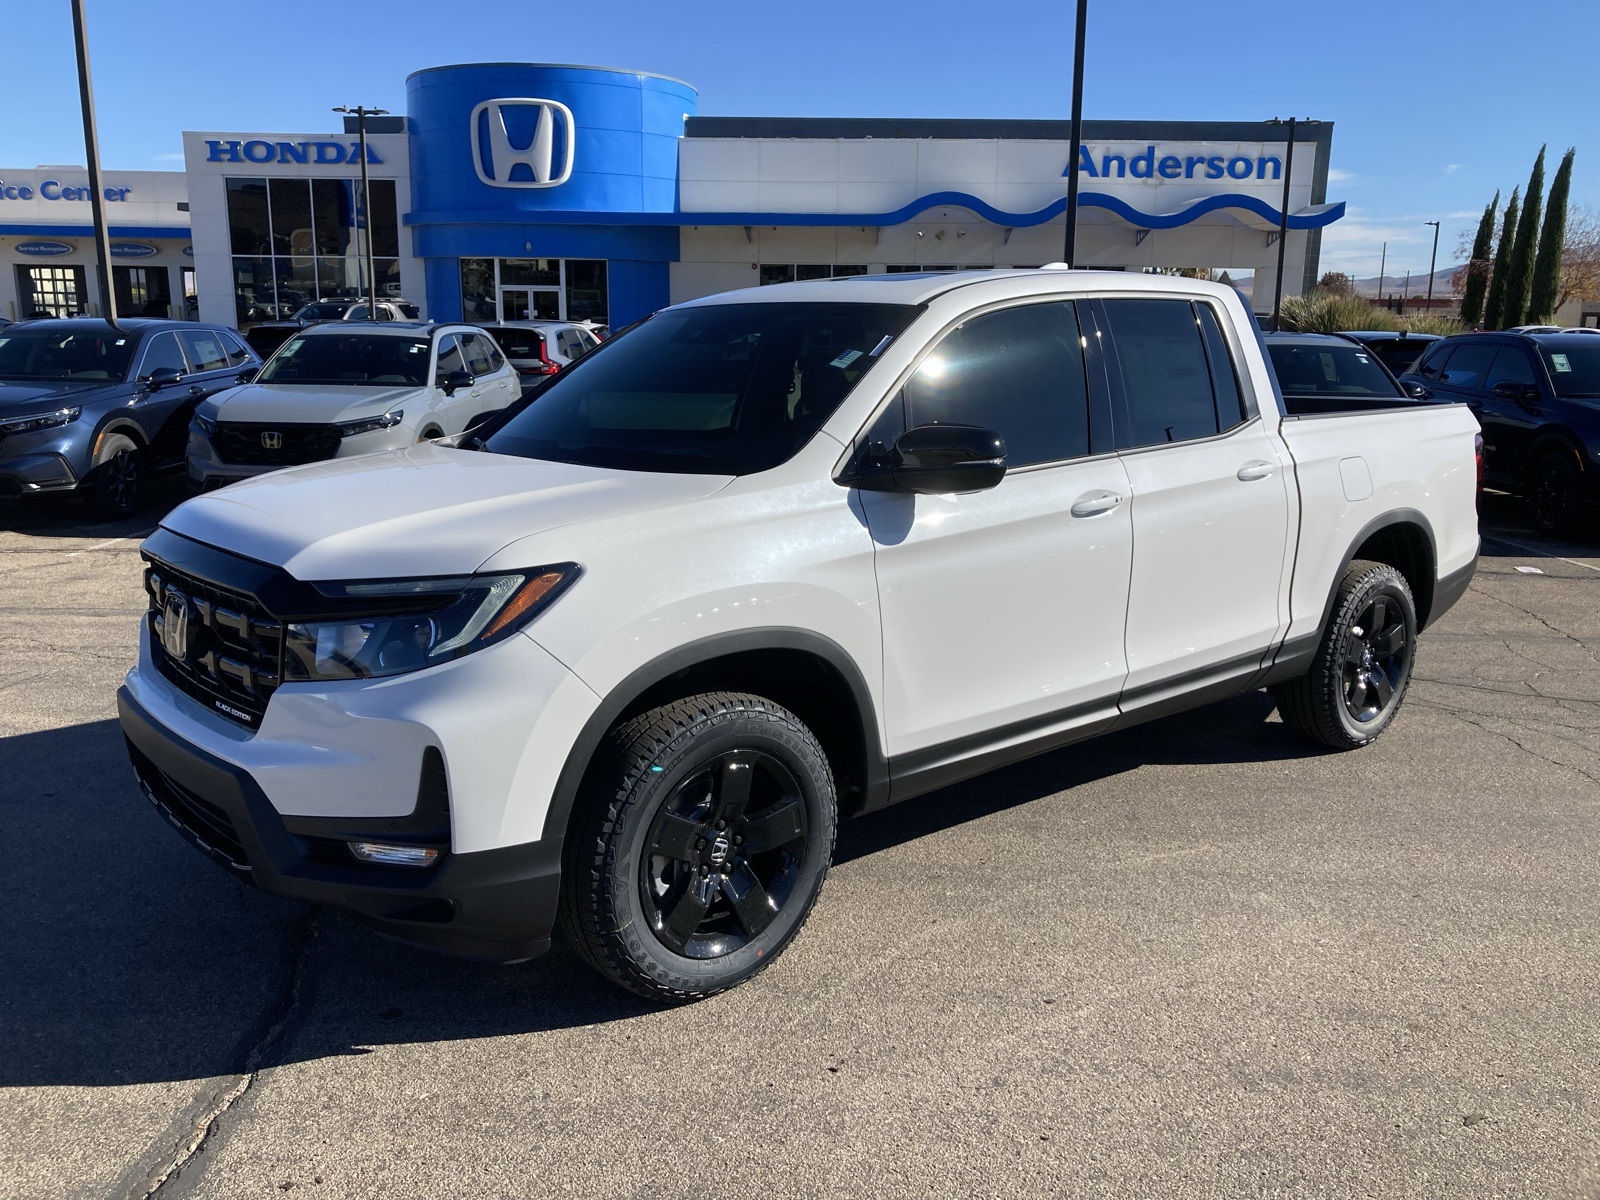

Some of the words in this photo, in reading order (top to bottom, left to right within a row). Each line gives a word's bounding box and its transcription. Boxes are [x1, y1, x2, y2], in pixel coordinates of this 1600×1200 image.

[204, 140, 384, 165] HONDA
[1062, 144, 1281, 180] Anderson
[40, 180, 131, 202] Cener
[40, 245, 69, 253] Reception
[216, 700, 231, 713] BLACK
[231, 708, 252, 722] EDITION
